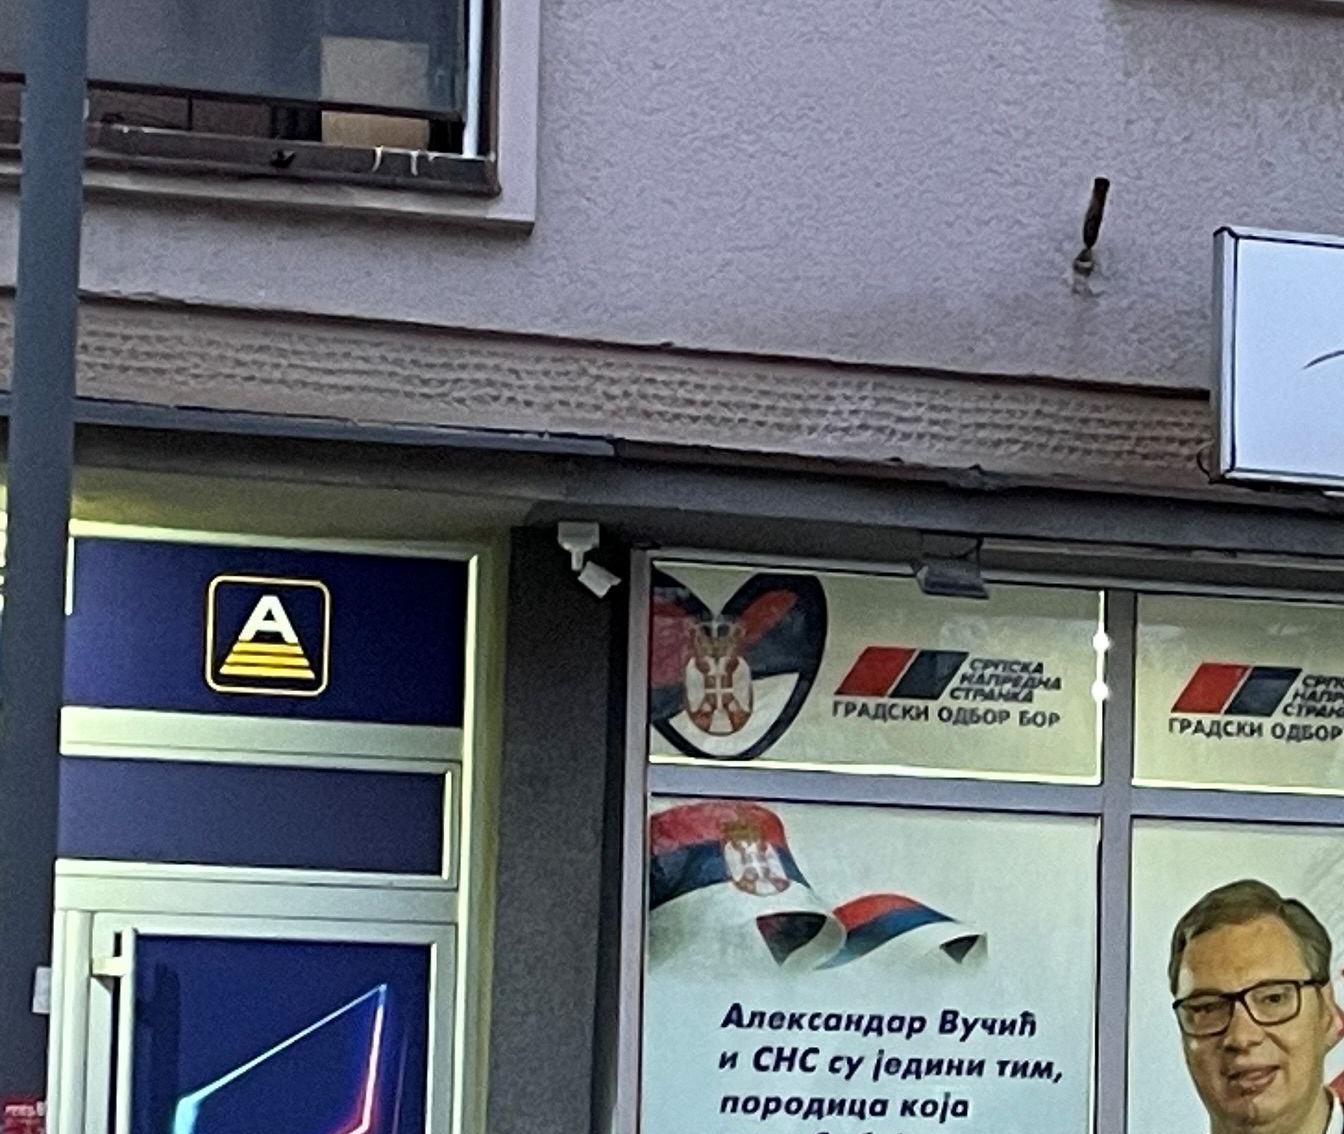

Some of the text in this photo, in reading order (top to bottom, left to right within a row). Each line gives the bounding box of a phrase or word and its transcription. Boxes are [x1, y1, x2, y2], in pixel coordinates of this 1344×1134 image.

[968, 657, 1044, 675] СРПСКА
[950, 686, 1034, 703] СТРАНКА
[959, 672, 1063, 691] НАПРЕДНА
[831, 700, 1062, 728] ГРАДСКИ ОДБОР БОР
[1168, 717, 1264, 739] ГРАДСКИ
[1270, 723, 1343, 742] ОДБОР
[720, 1002, 1037, 1042] Александар Вучић
[717, 1046, 1064, 1083] и СНС су једини тим,
[719, 1092, 969, 1123] породица која
